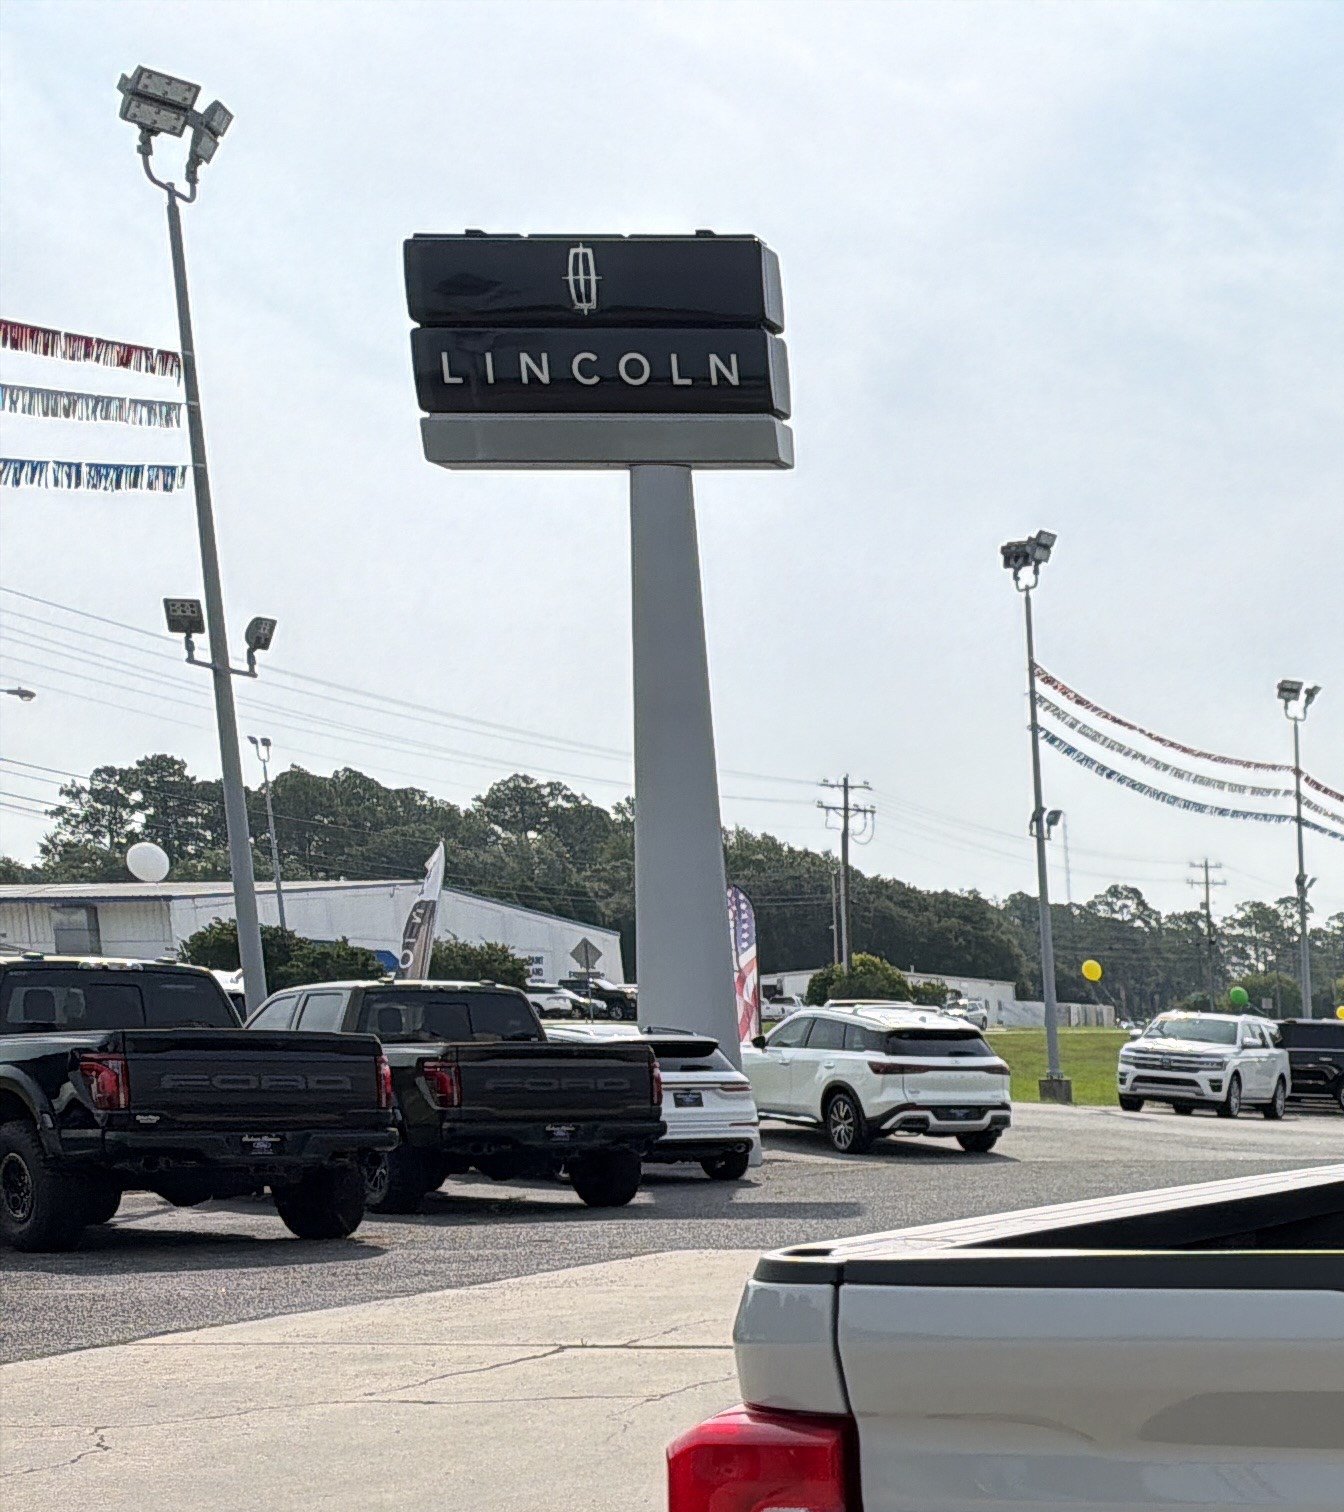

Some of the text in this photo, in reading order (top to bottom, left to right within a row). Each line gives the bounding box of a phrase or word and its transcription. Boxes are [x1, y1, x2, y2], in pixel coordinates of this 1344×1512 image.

[441, 351, 741, 387] LINCOLN
[160, 1074, 352, 1090] FORD
[484, 1077, 632, 1091] FORD
